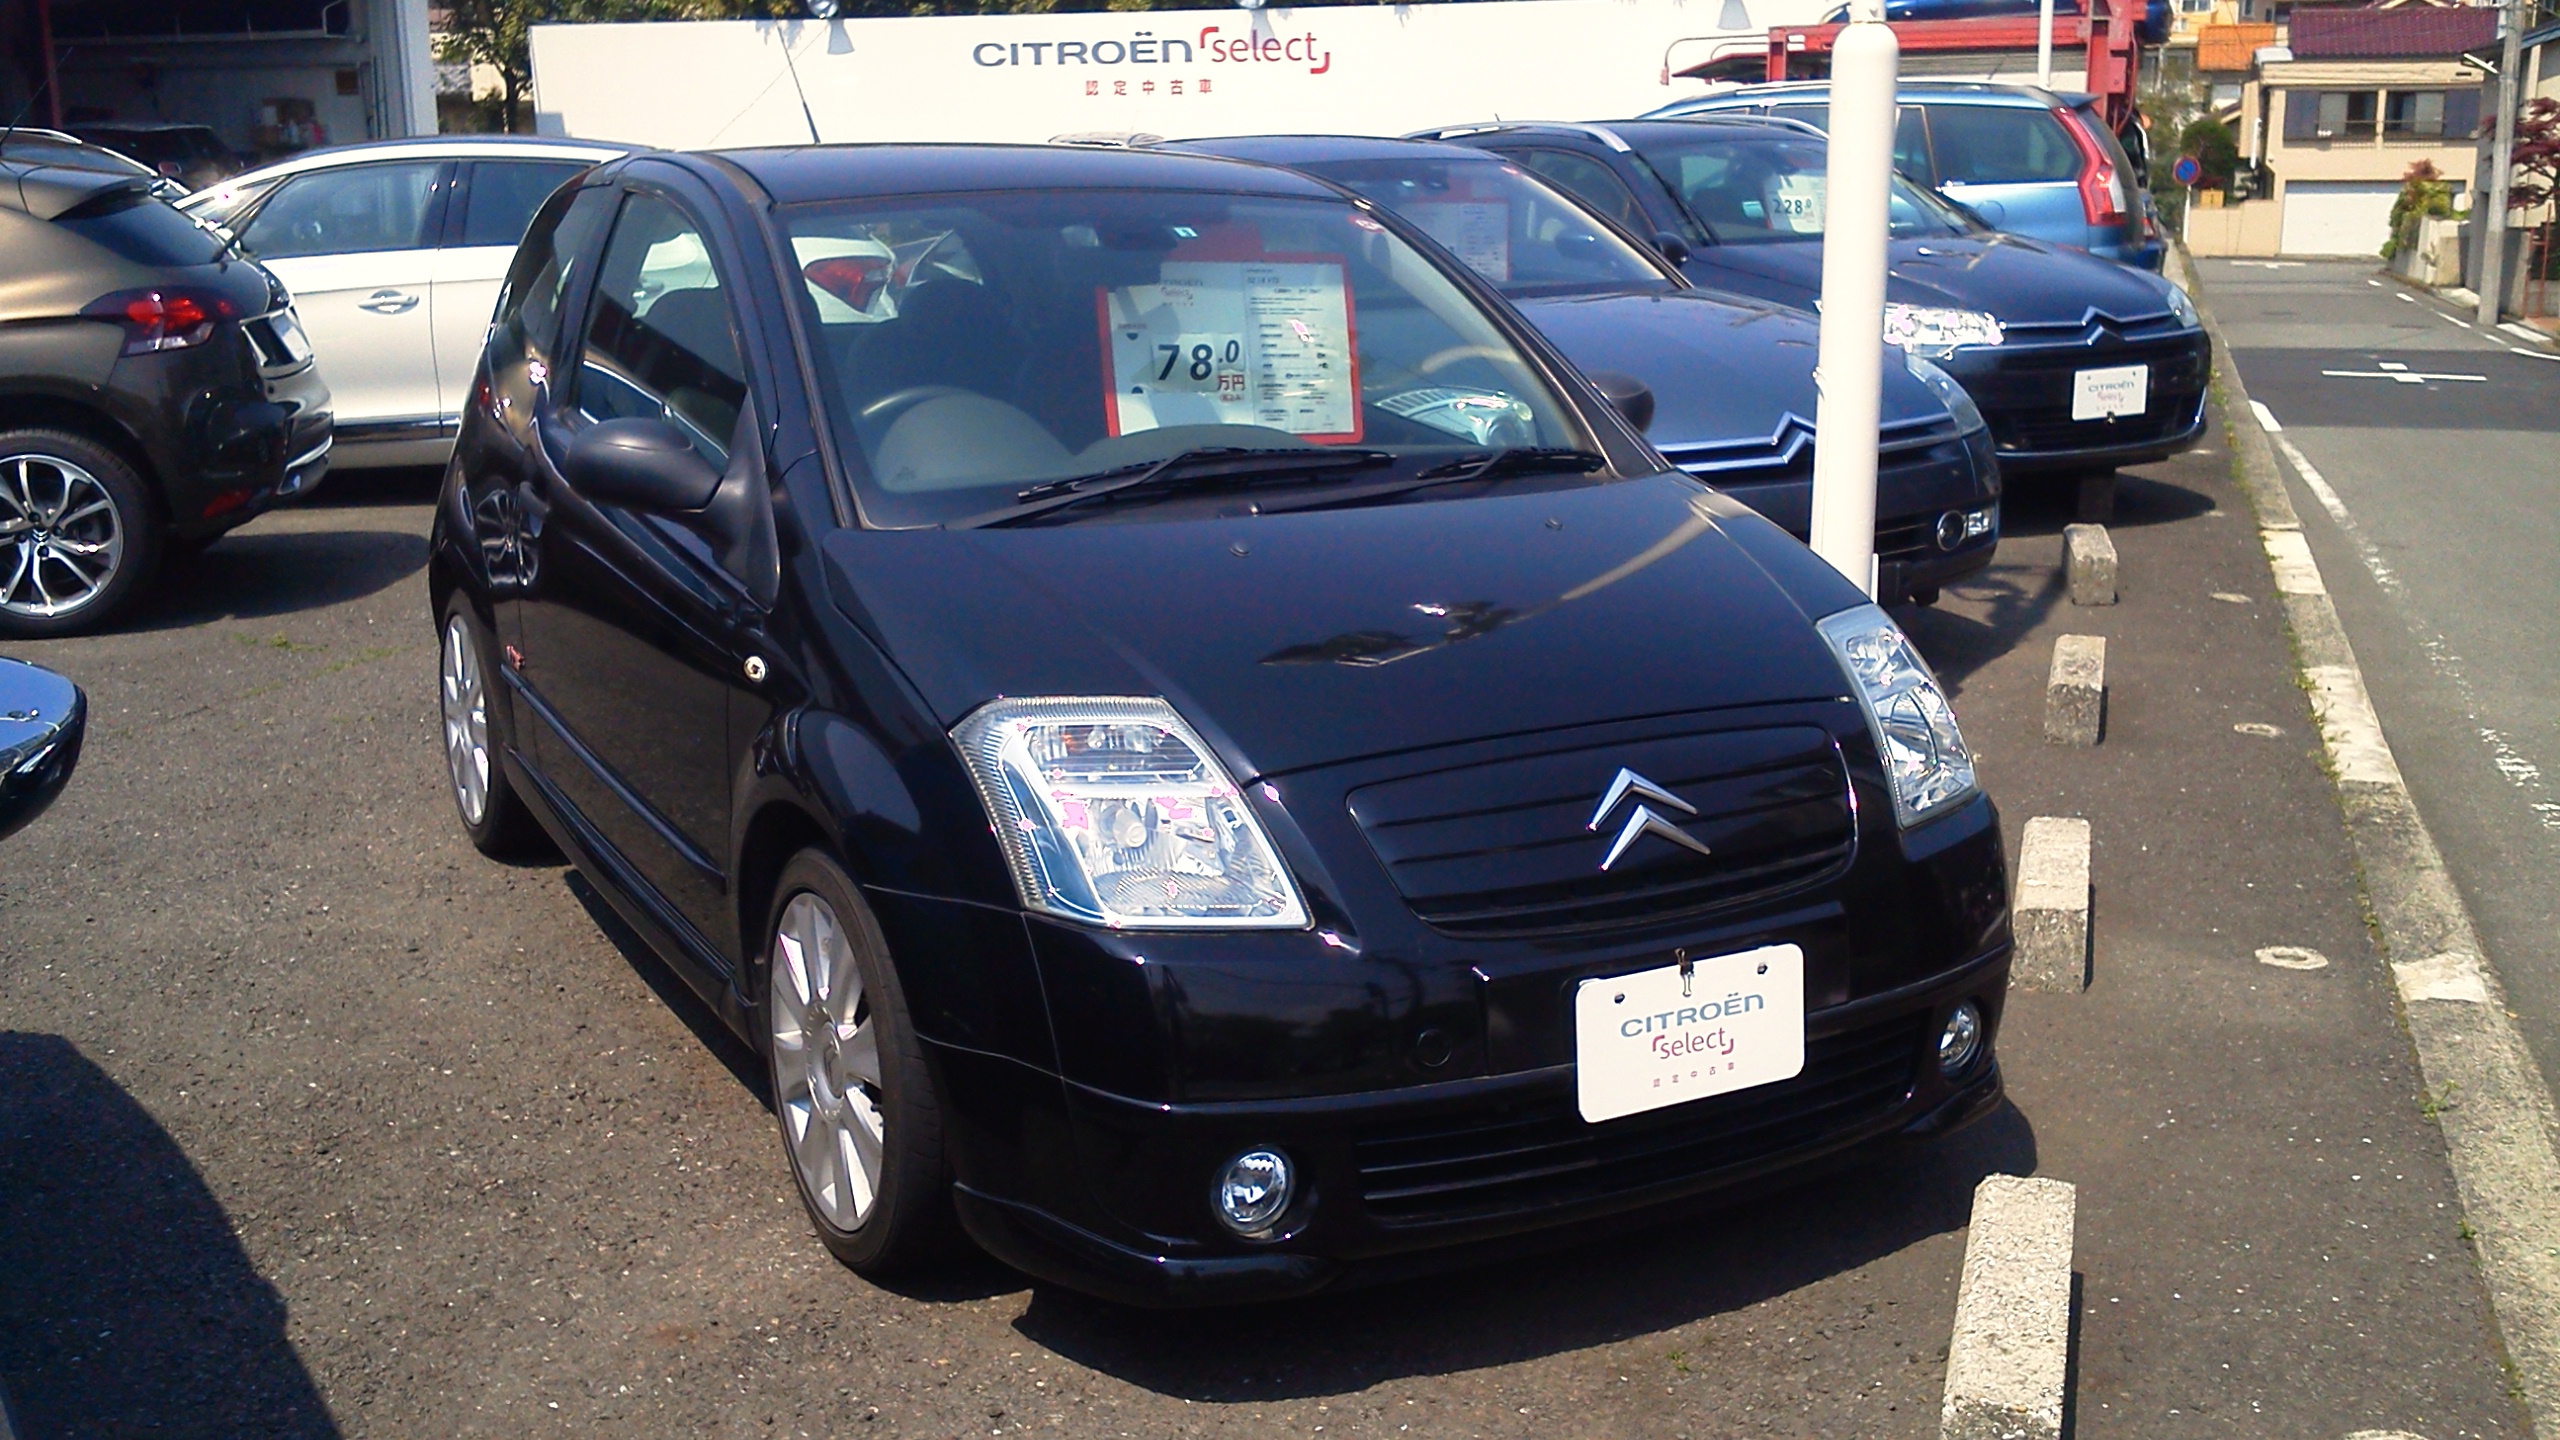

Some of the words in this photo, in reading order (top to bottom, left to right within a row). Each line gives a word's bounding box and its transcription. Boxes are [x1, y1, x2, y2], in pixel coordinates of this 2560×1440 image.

[1085, 78, 1213, 96] 認定中古車
[1217, 374, 1245, 391] 万円
